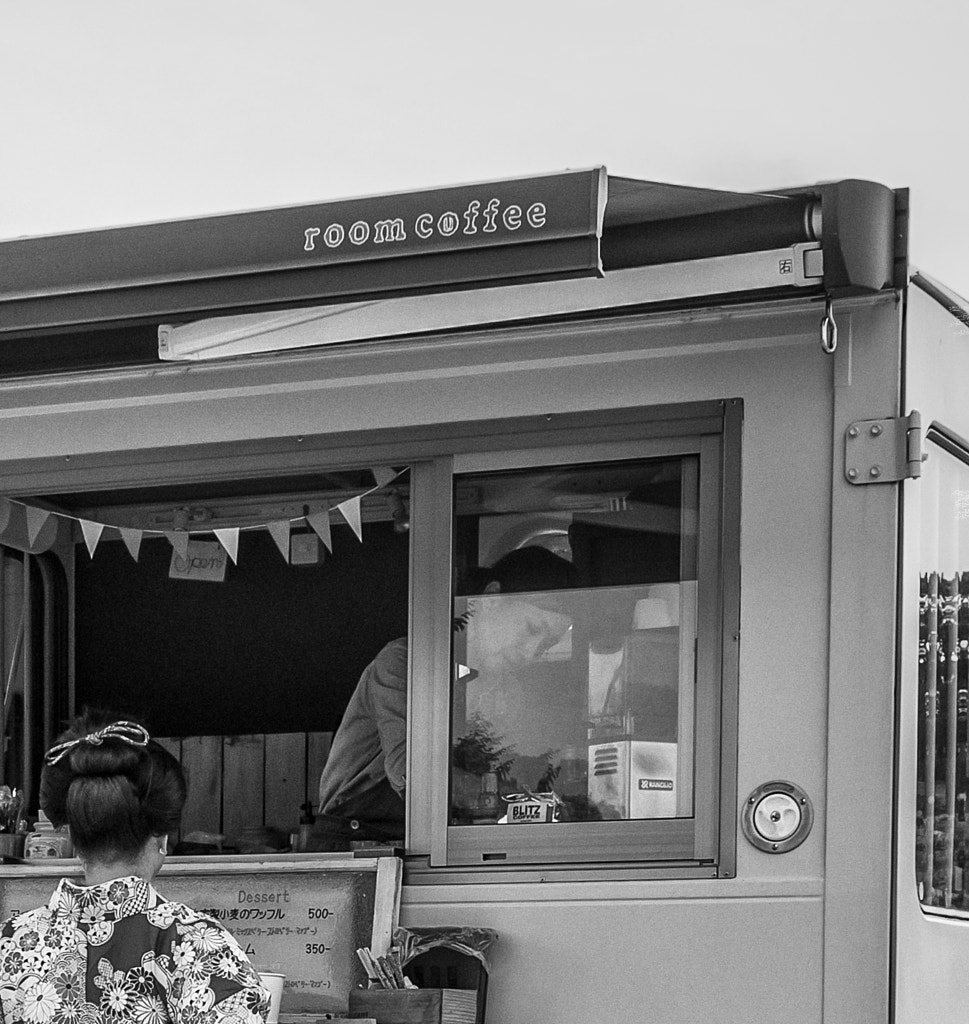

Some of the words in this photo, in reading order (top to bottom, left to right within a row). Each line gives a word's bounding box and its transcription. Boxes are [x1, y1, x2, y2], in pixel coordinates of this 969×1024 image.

[303, 217, 407, 251] room
[415, 198, 547, 240] coffee
[512, 805, 541, 815] BLITZ
[238, 890, 290, 904] Dessert
[308, 908, 334, 920] 500-
[305, 943, 331, 954] 350-
